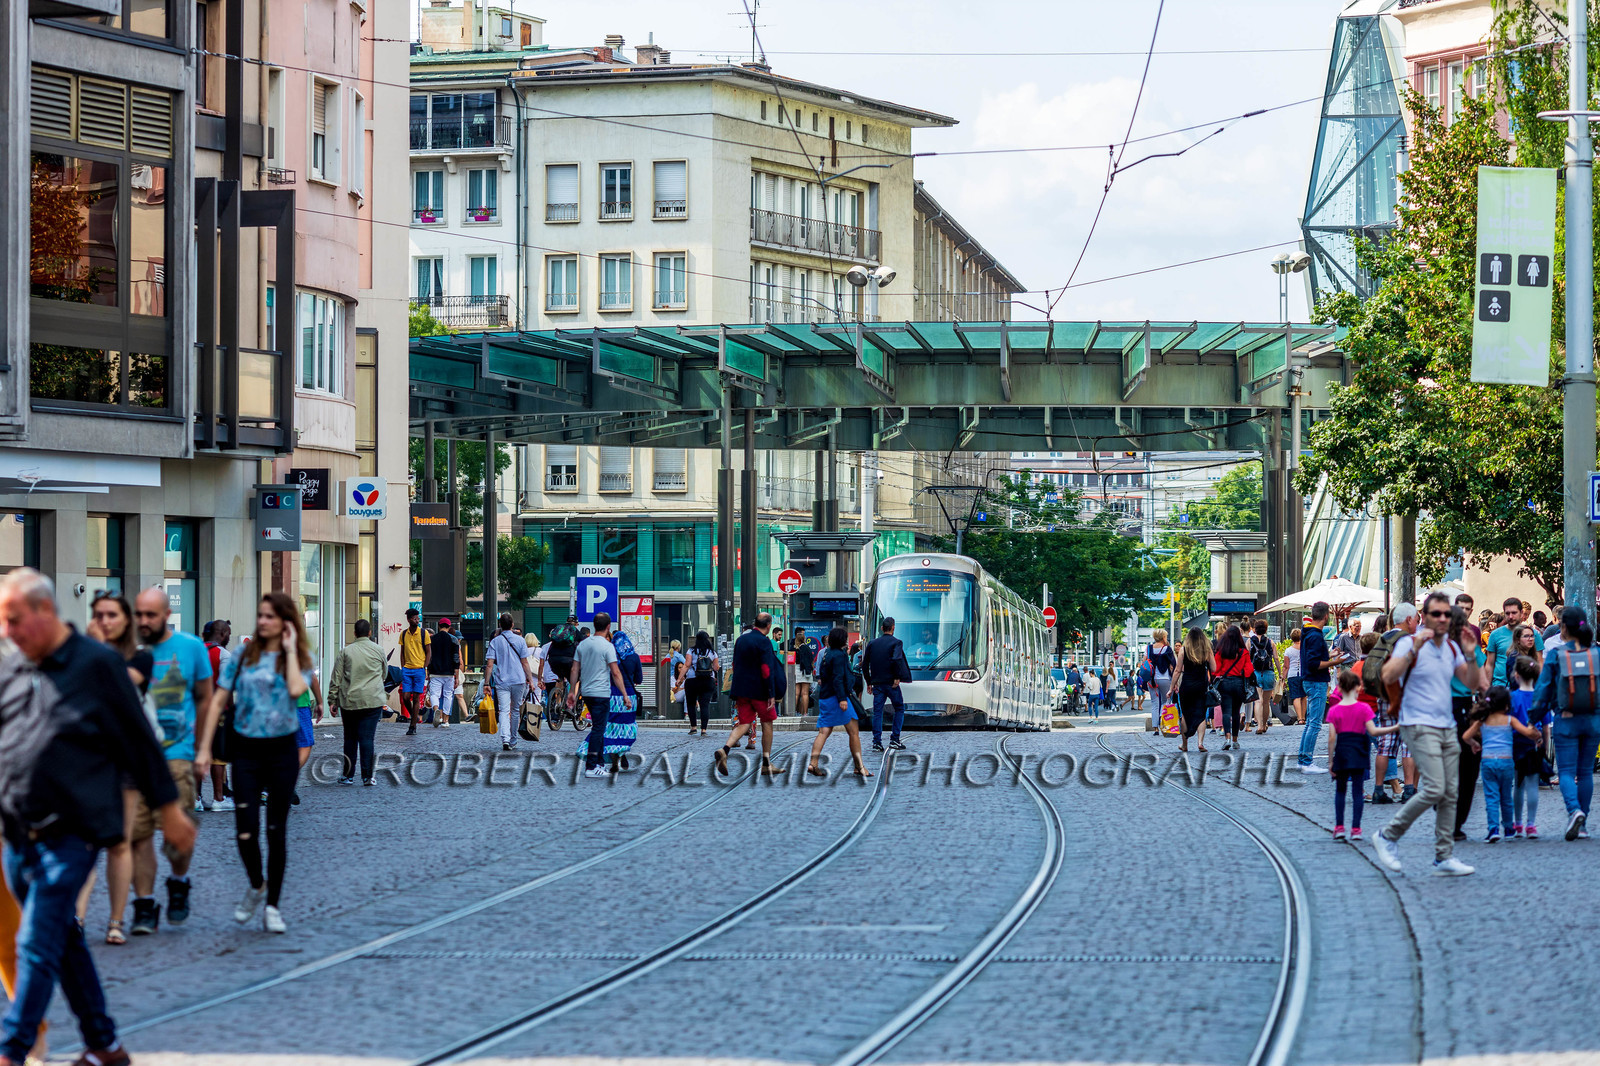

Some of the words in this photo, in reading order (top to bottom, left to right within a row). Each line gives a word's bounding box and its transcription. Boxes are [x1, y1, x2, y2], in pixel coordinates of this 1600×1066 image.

[1505, 185, 1530, 208] ici
[265, 495, 292, 506] CIC
[349, 507, 382, 517] bouygues
[413, 516, 447, 525] Tandem
[586, 585, 607, 613] P
